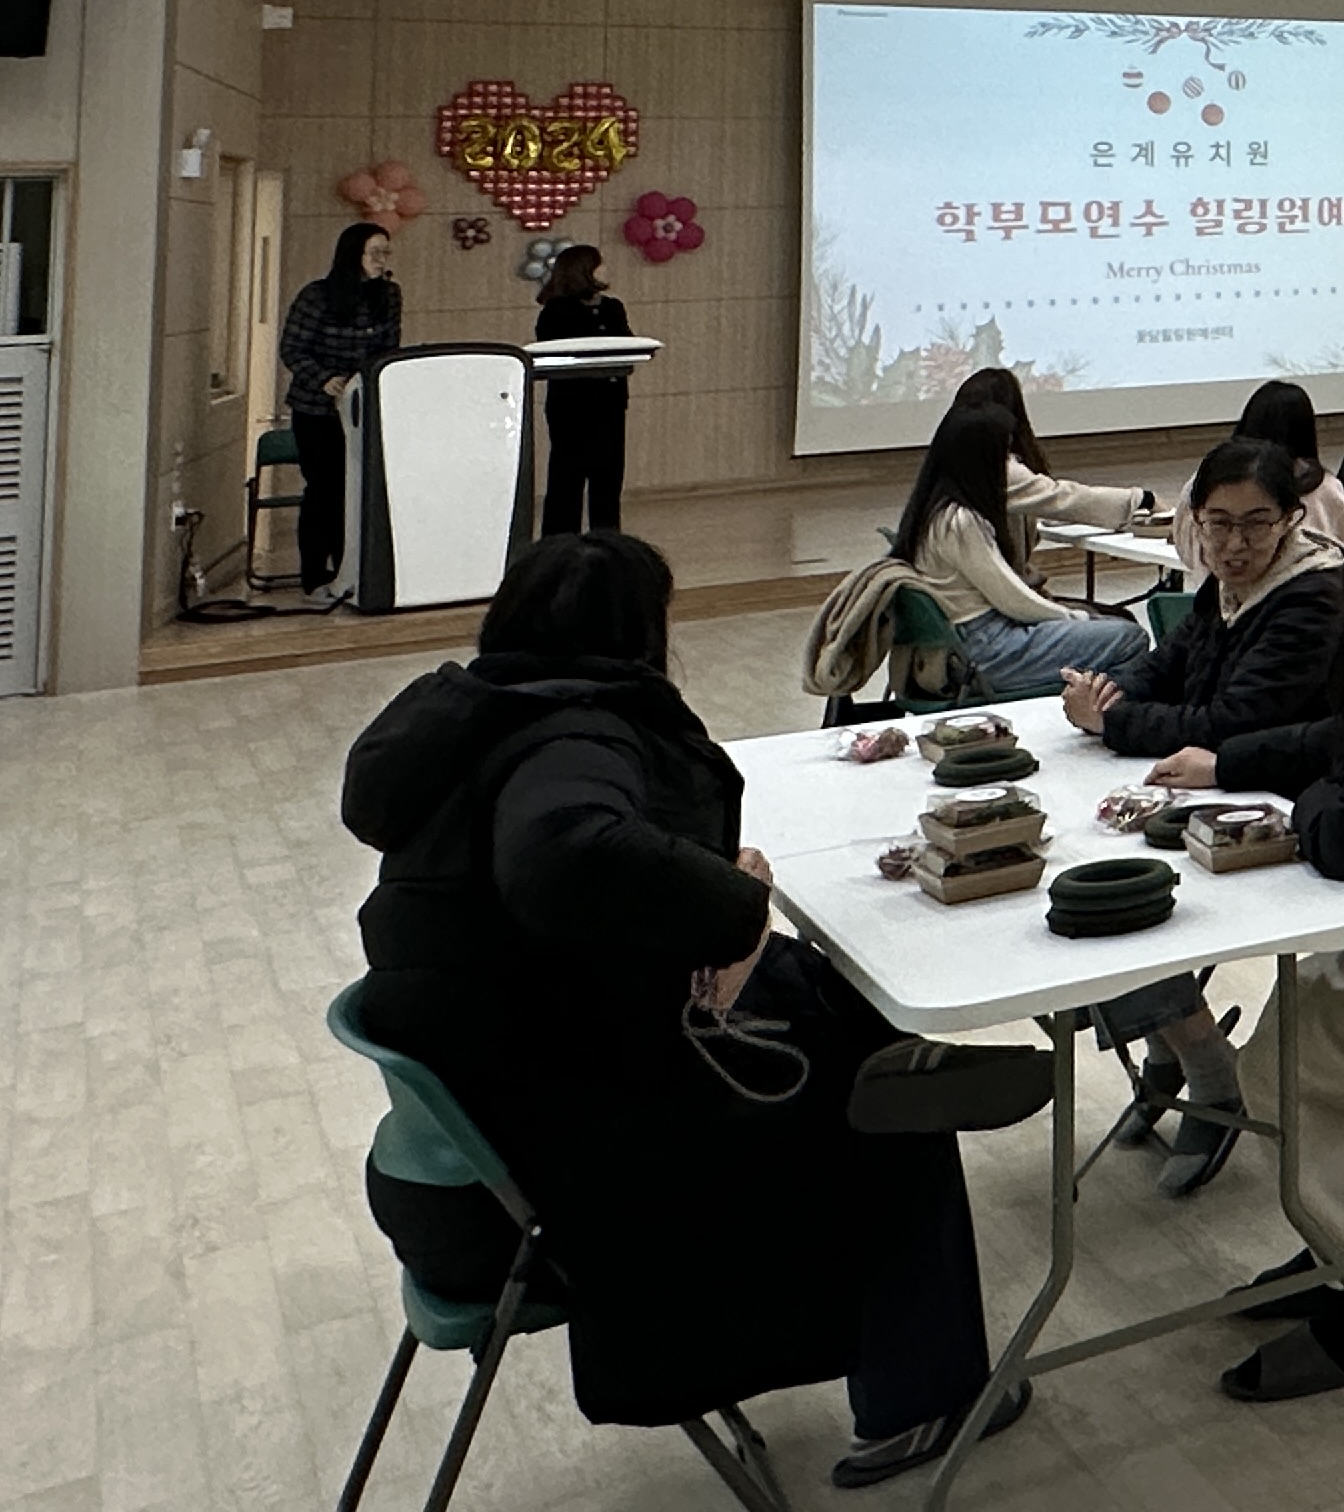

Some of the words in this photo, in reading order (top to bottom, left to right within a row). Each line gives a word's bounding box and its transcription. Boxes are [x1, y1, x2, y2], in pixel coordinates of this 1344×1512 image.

[456, 116, 628, 171] 2024
[1088, 139, 1271, 168] 은계유치원
[935, 198, 1170, 243] 학부모연수
[1106, 261, 1163, 284] Merry
[1168, 258, 1262, 277] Christmas
